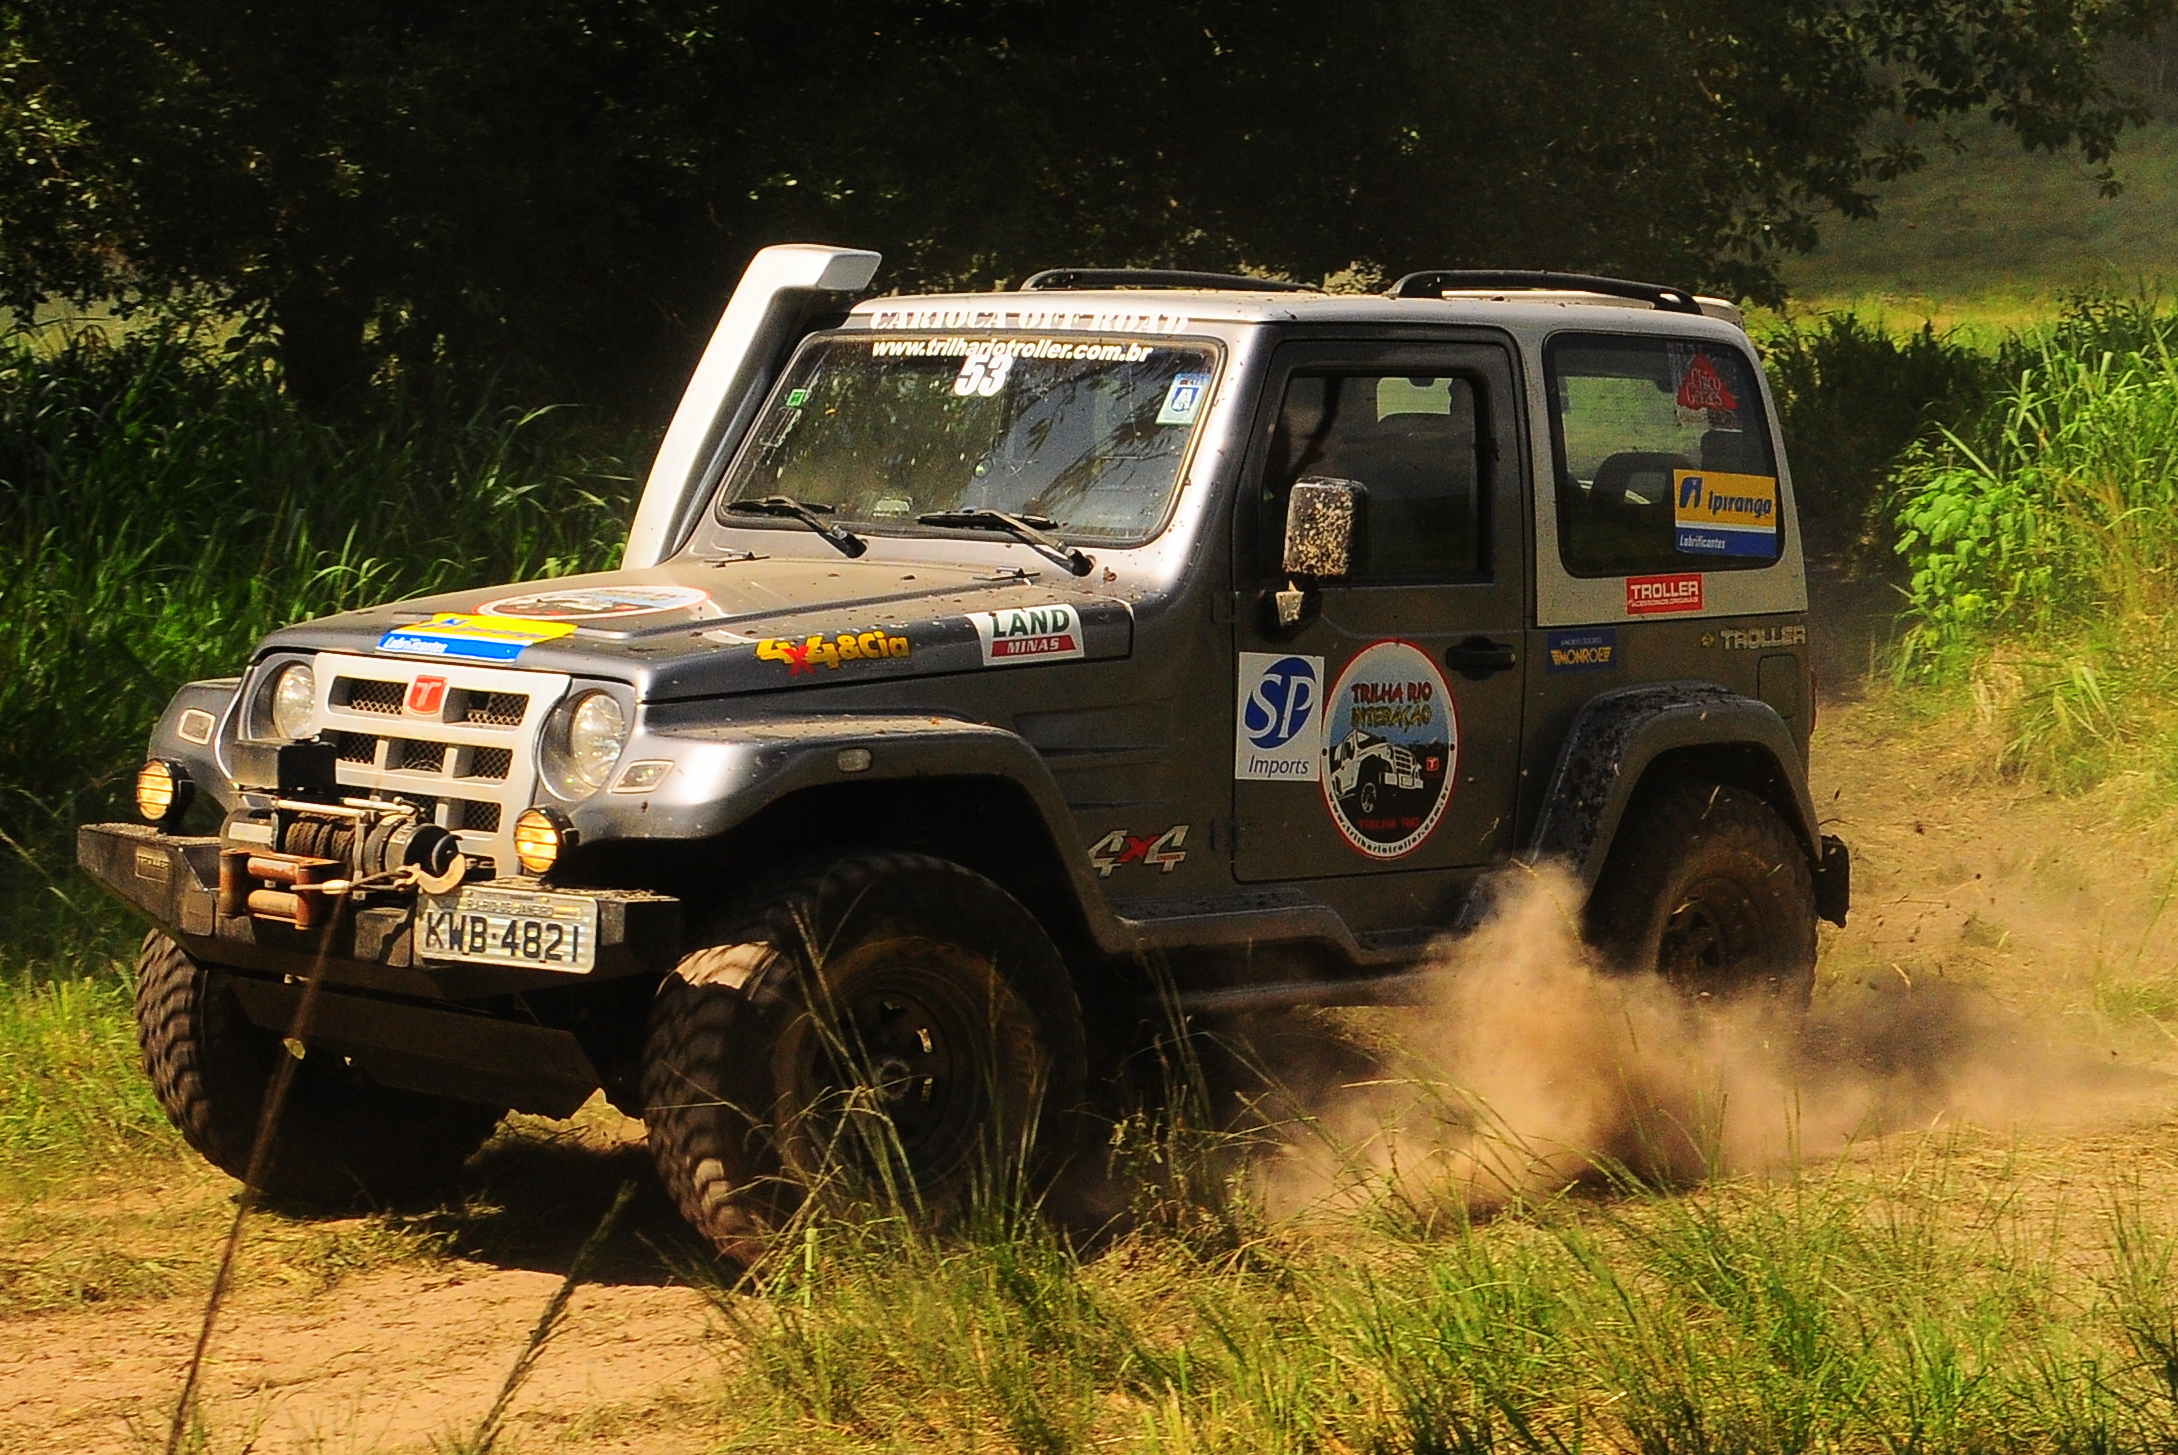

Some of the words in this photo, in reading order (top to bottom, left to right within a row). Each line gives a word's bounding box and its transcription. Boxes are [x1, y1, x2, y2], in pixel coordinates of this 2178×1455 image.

[869, 309, 1006, 329] CARIOCA
[1016, 310, 1080, 331] OFF
[1087, 312, 1189, 335] ROAD
[871, 338, 1154, 362] www.trilhariotroller.com.br
[953, 353, 1014, 397] 53
[1707, 489, 1772, 520] Ipiranga
[1679, 533, 1726, 550] Lubrificantes
[1630, 580, 1699, 600] TROLLER
[992, 608, 1071, 638] LAND
[1006, 638, 1060, 652] MINAS
[1721, 624, 1806, 650] TROLLER
[1555, 646, 1609, 665] MONROE
[1351, 682, 1404, 703] TRILHA
[1407, 680, 1433, 701] RIO
[1246, 673, 1317, 739] SP
[1248, 755, 1309, 777] Imports
